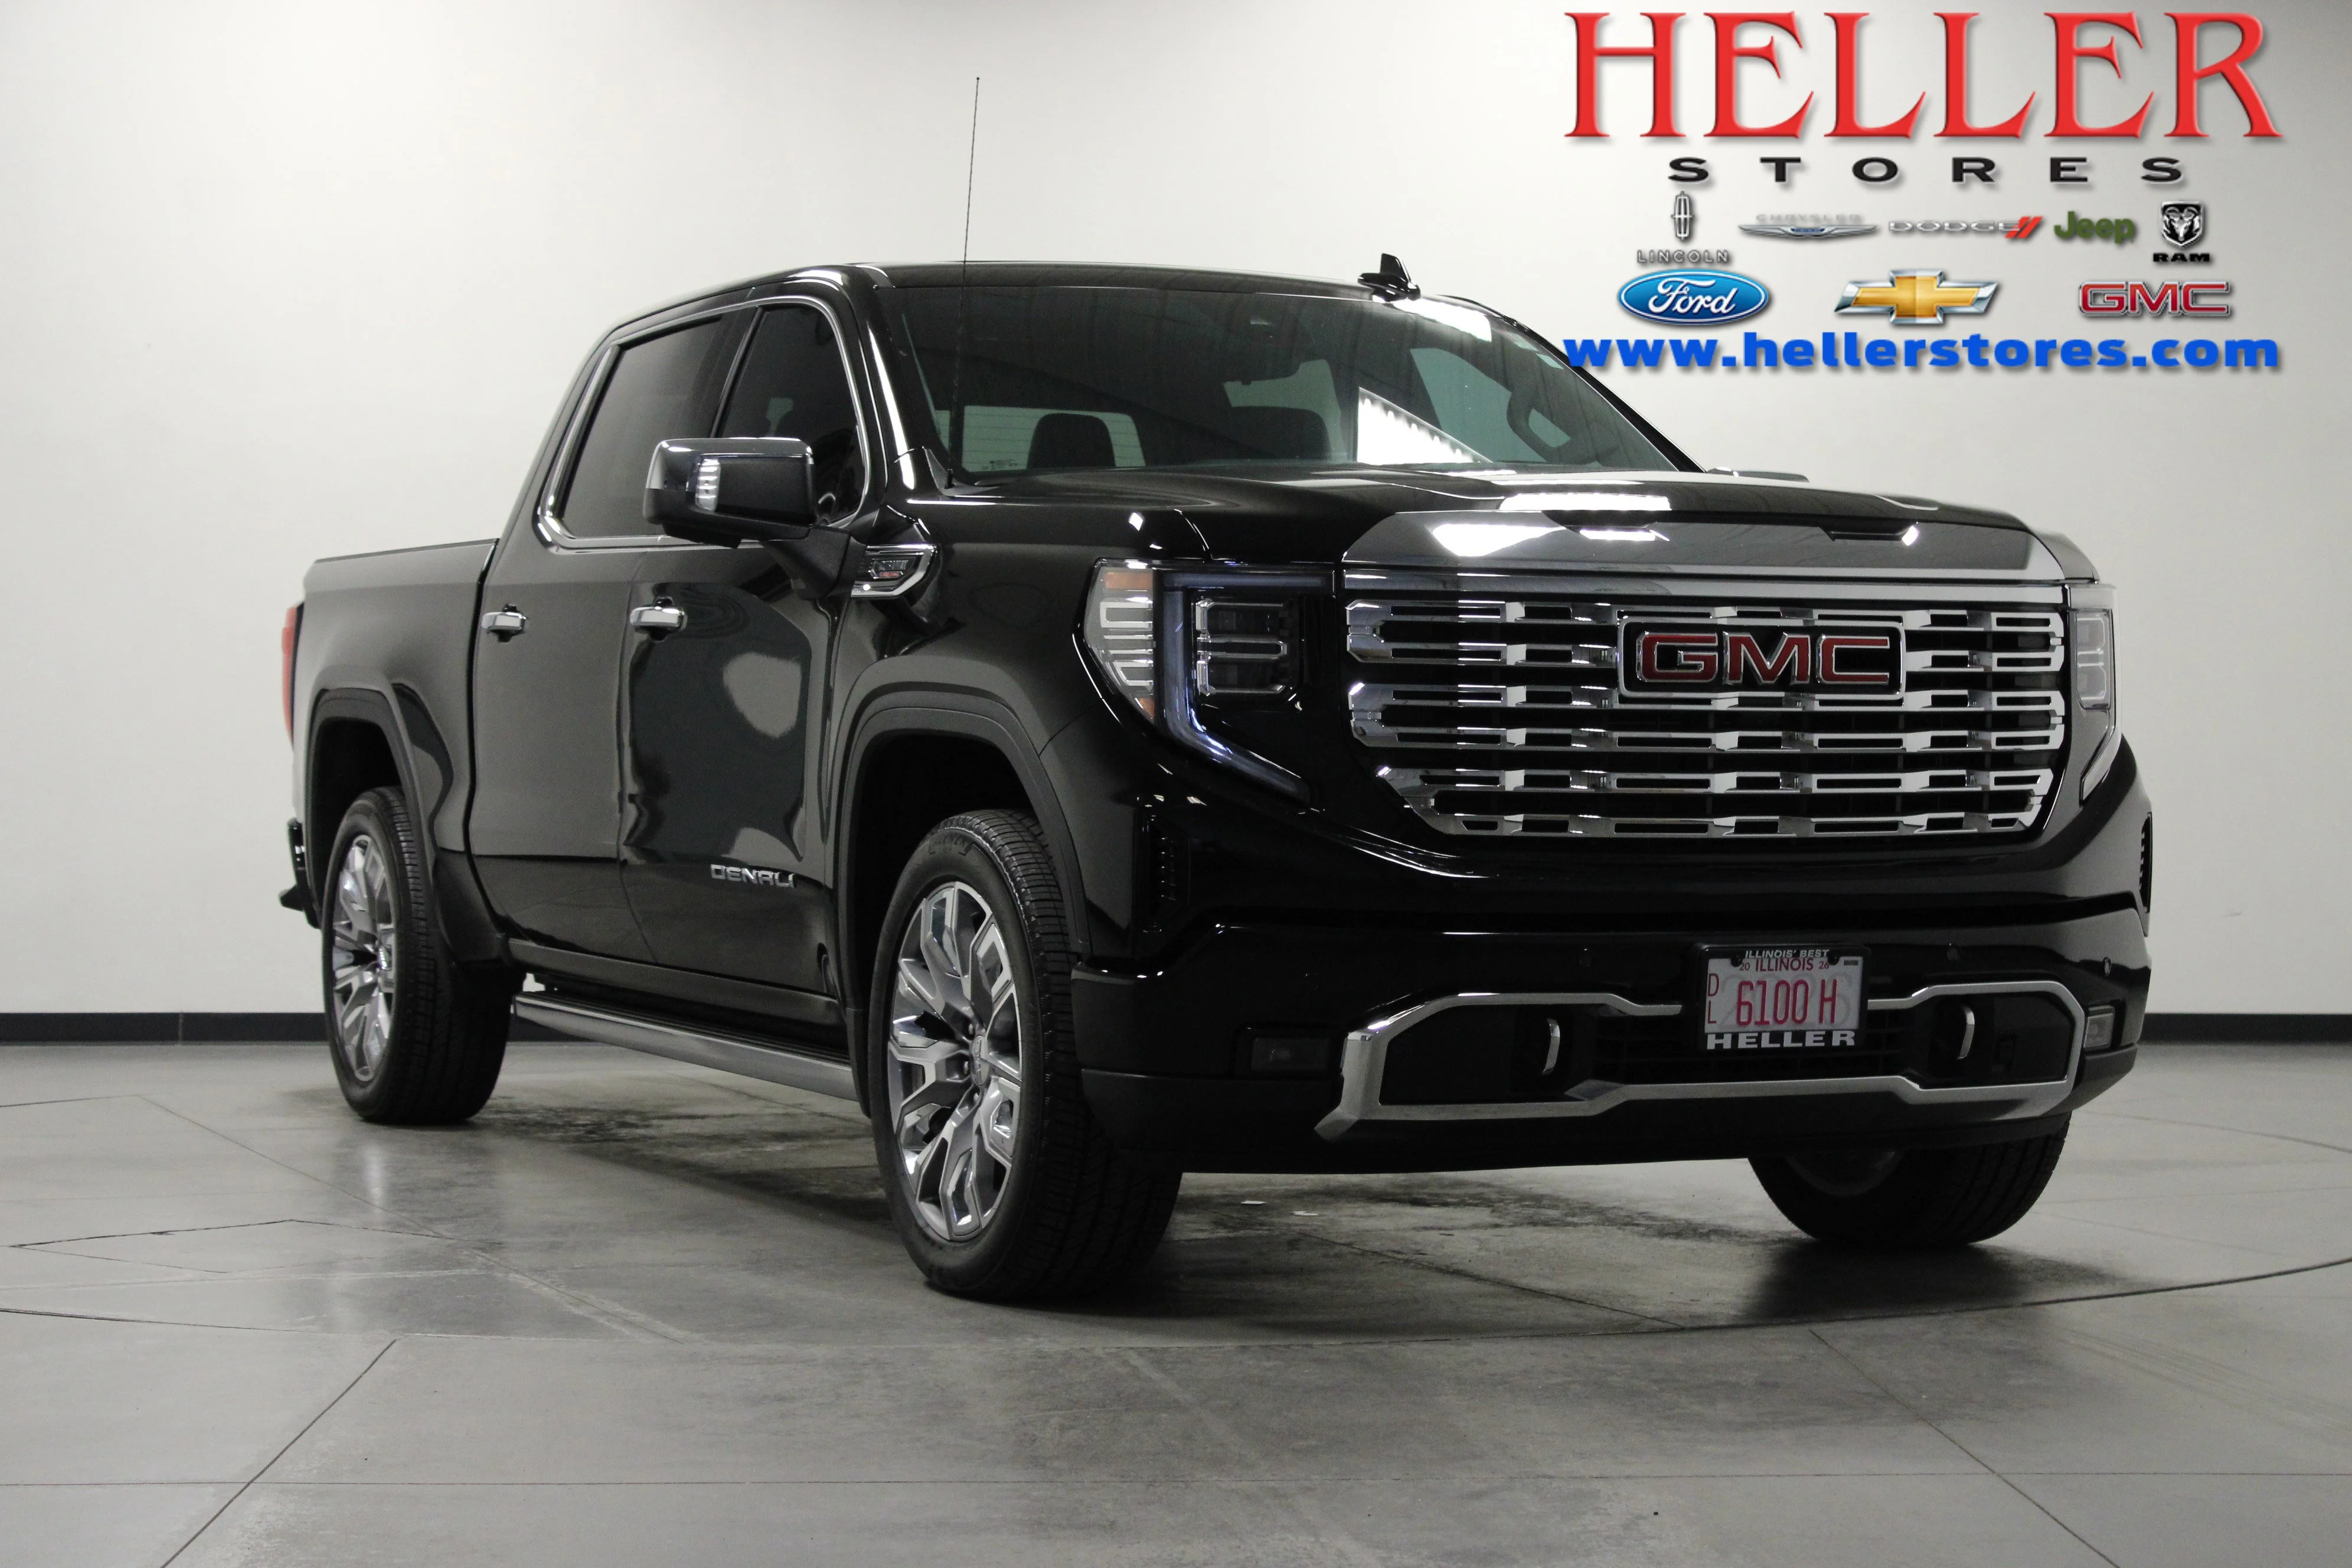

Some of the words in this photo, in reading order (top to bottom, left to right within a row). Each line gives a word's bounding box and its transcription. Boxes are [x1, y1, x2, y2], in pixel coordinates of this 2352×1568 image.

[1636, 632, 1890, 685] GMC
[711, 864, 796, 888] DENALI
[1755, 957, 1814, 972] ILLINOIS
[1818, 961, 1830, 969] 26
[1799, 949, 1830, 958] BEST
[1736, 979, 1809, 1025] 6100
[1818, 979, 1838, 1024] H
[1707, 1030, 1856, 1050] HELLER
